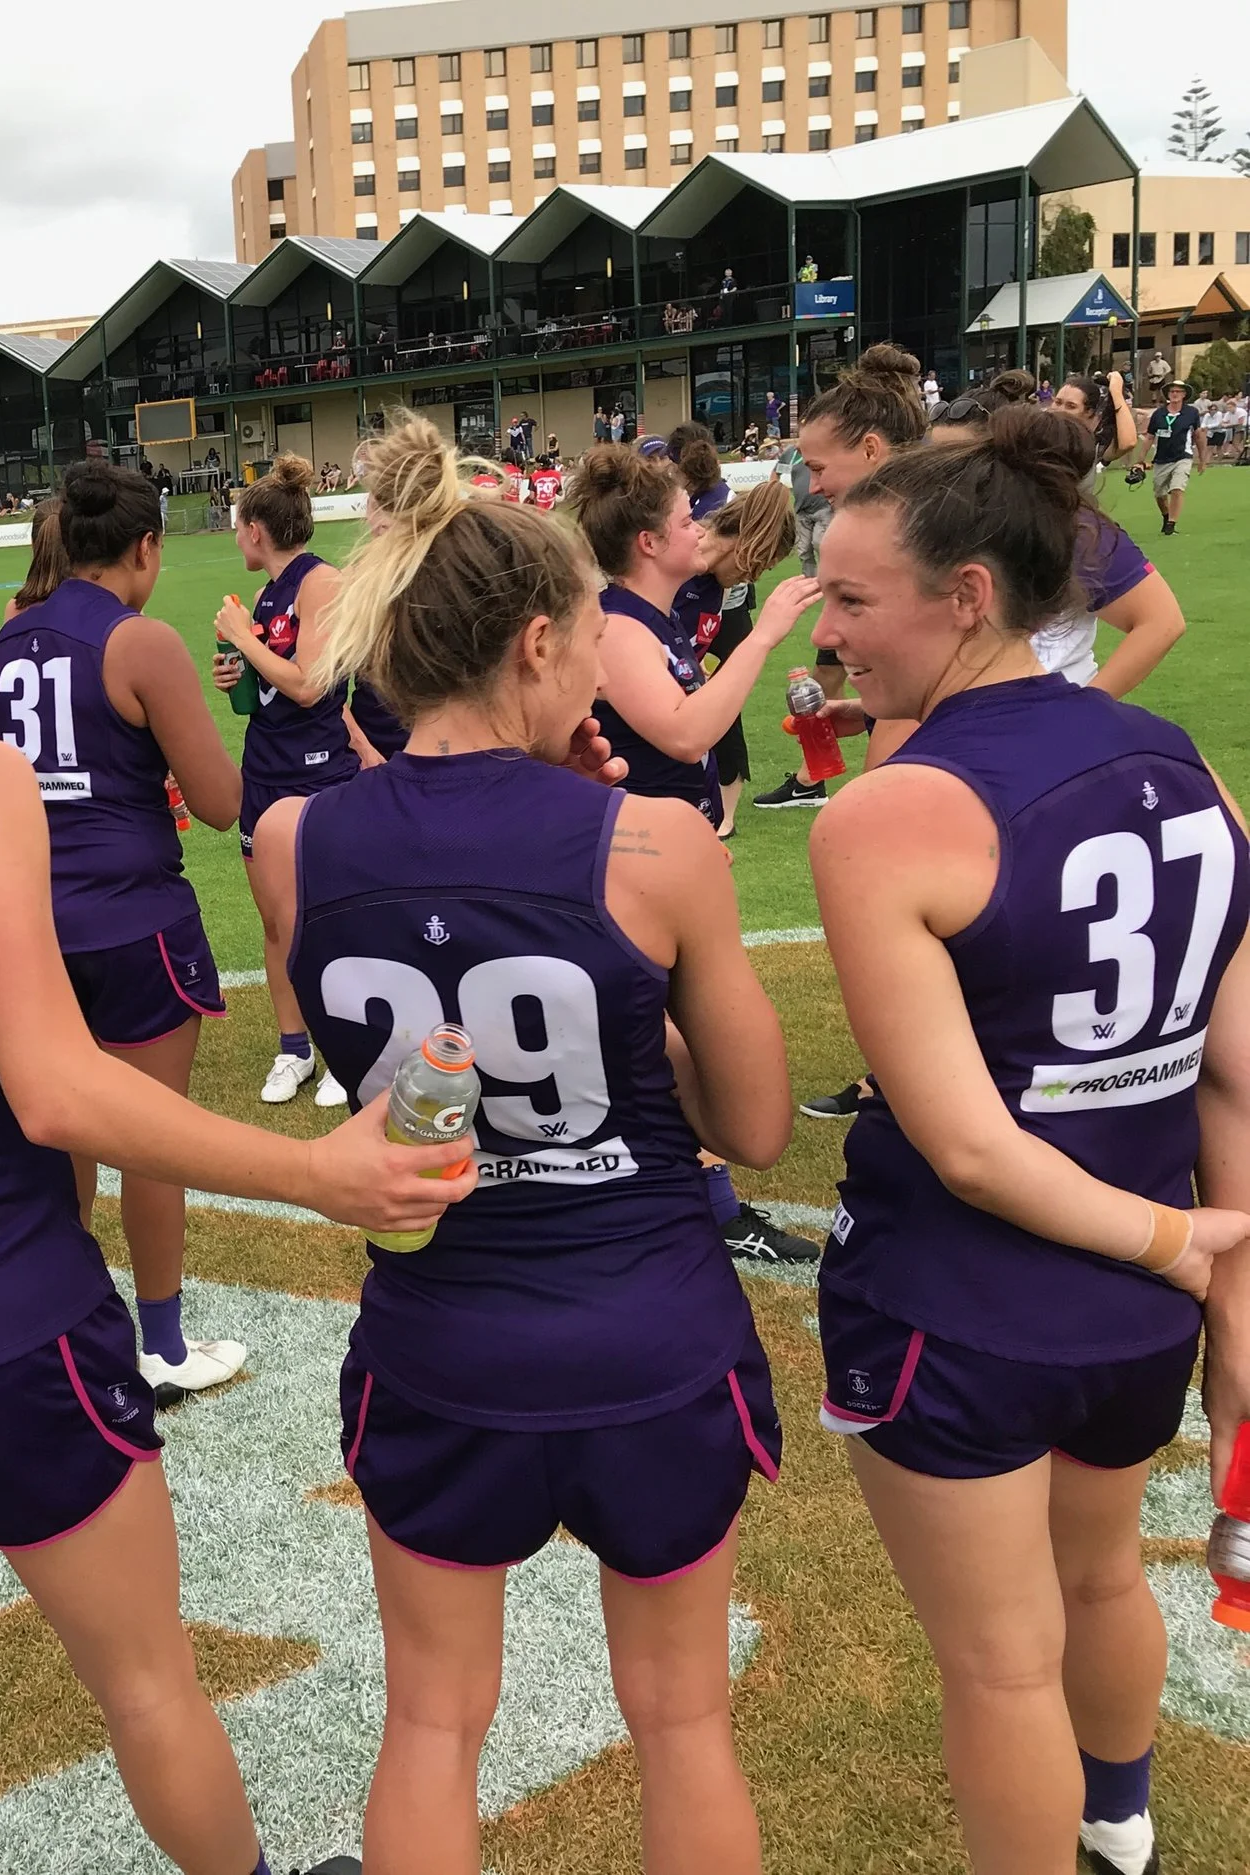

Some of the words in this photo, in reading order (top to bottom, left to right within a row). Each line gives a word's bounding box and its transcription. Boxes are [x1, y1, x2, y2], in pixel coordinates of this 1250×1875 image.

[815, 294, 837, 305] Library
[38, 781, 85, 791] RAMMED
[1051, 804, 1236, 1052] 37
[320, 955, 612, 1148] 29
[419, 1126, 468, 1139] GATORADE
[477, 1153, 621, 1179] GRAMED
